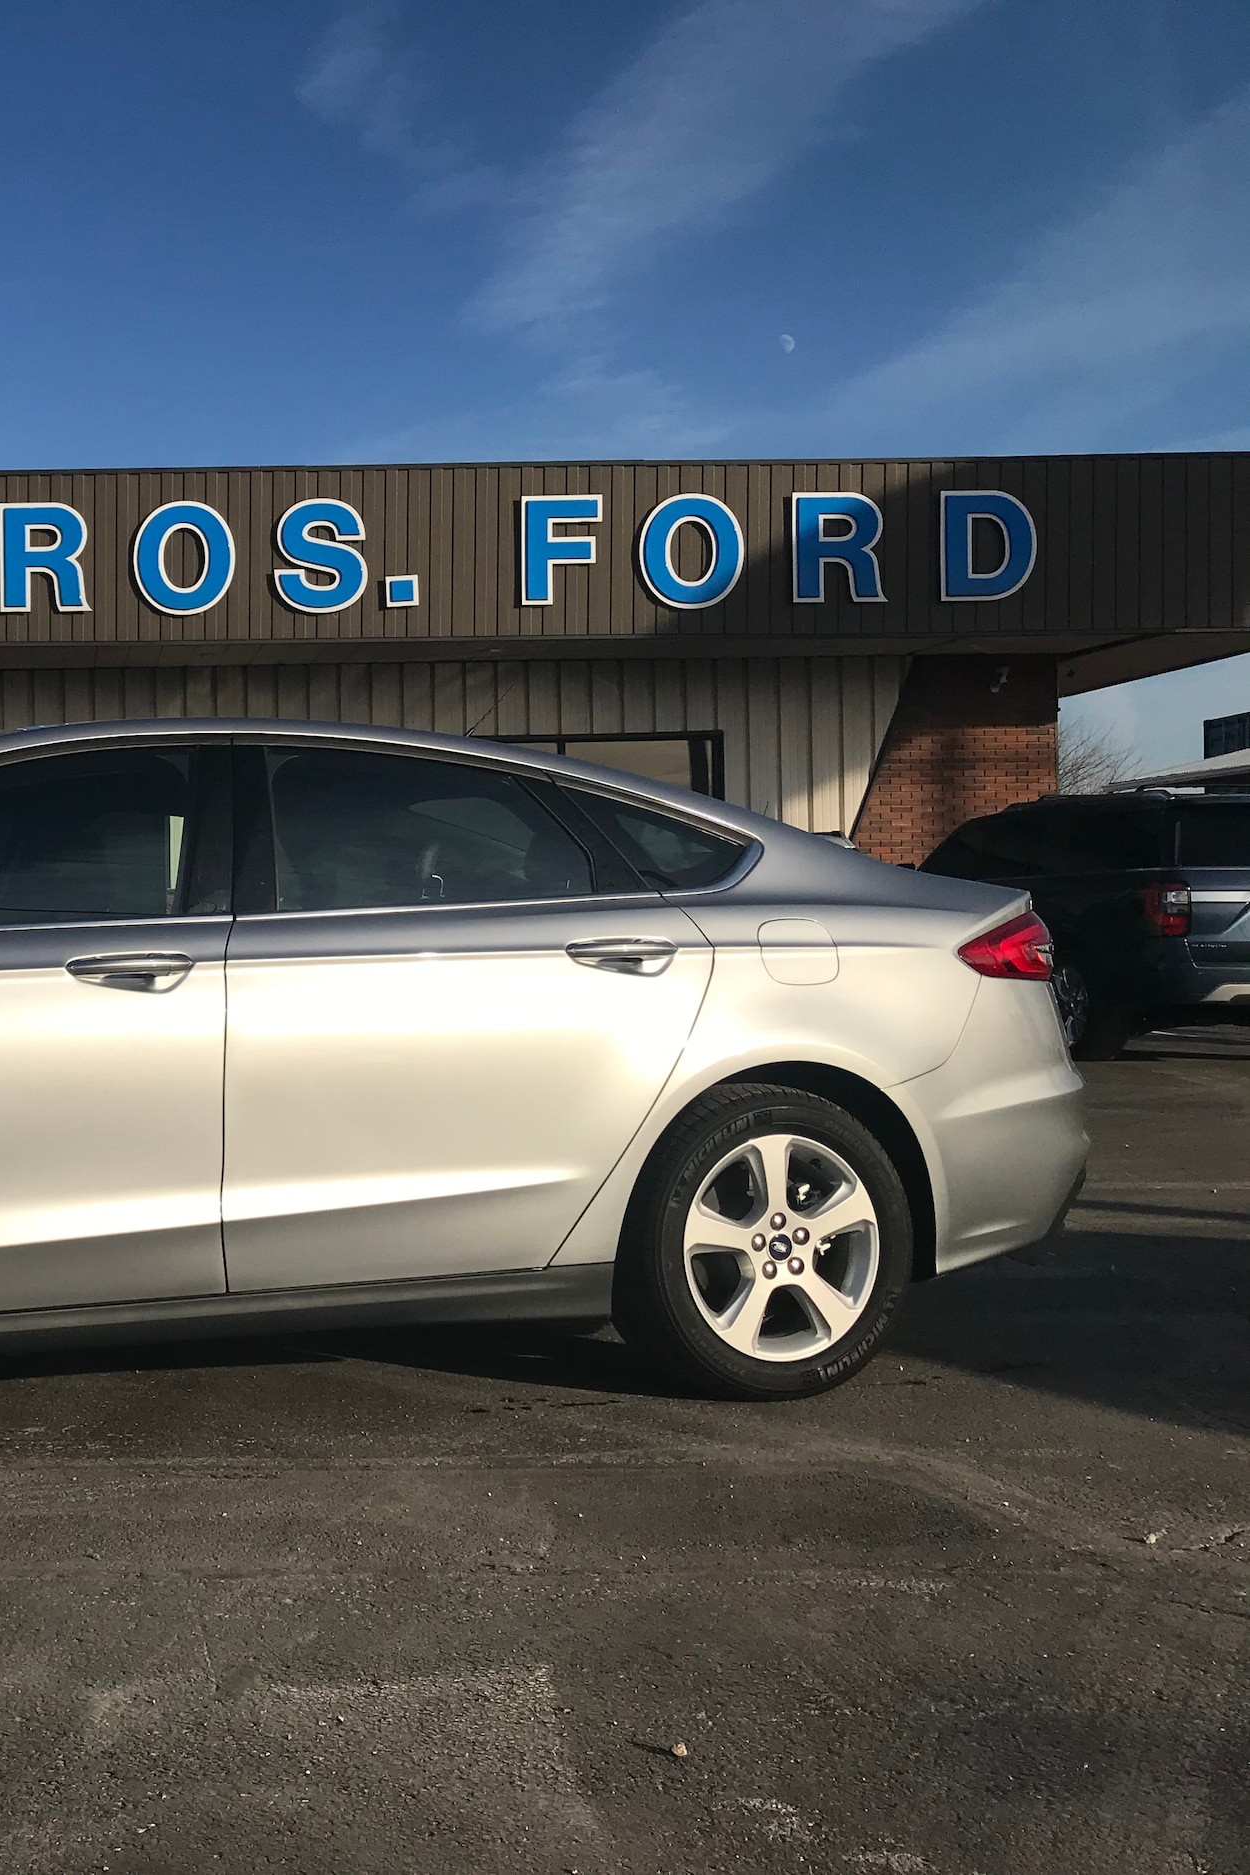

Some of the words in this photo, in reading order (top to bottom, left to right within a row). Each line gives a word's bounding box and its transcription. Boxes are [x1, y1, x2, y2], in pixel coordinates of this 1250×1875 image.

[520, 490, 1037, 609] FORD
[682, 1116, 749, 1182] MICHELIN
[826, 1312, 889, 1379] MICHELIN
